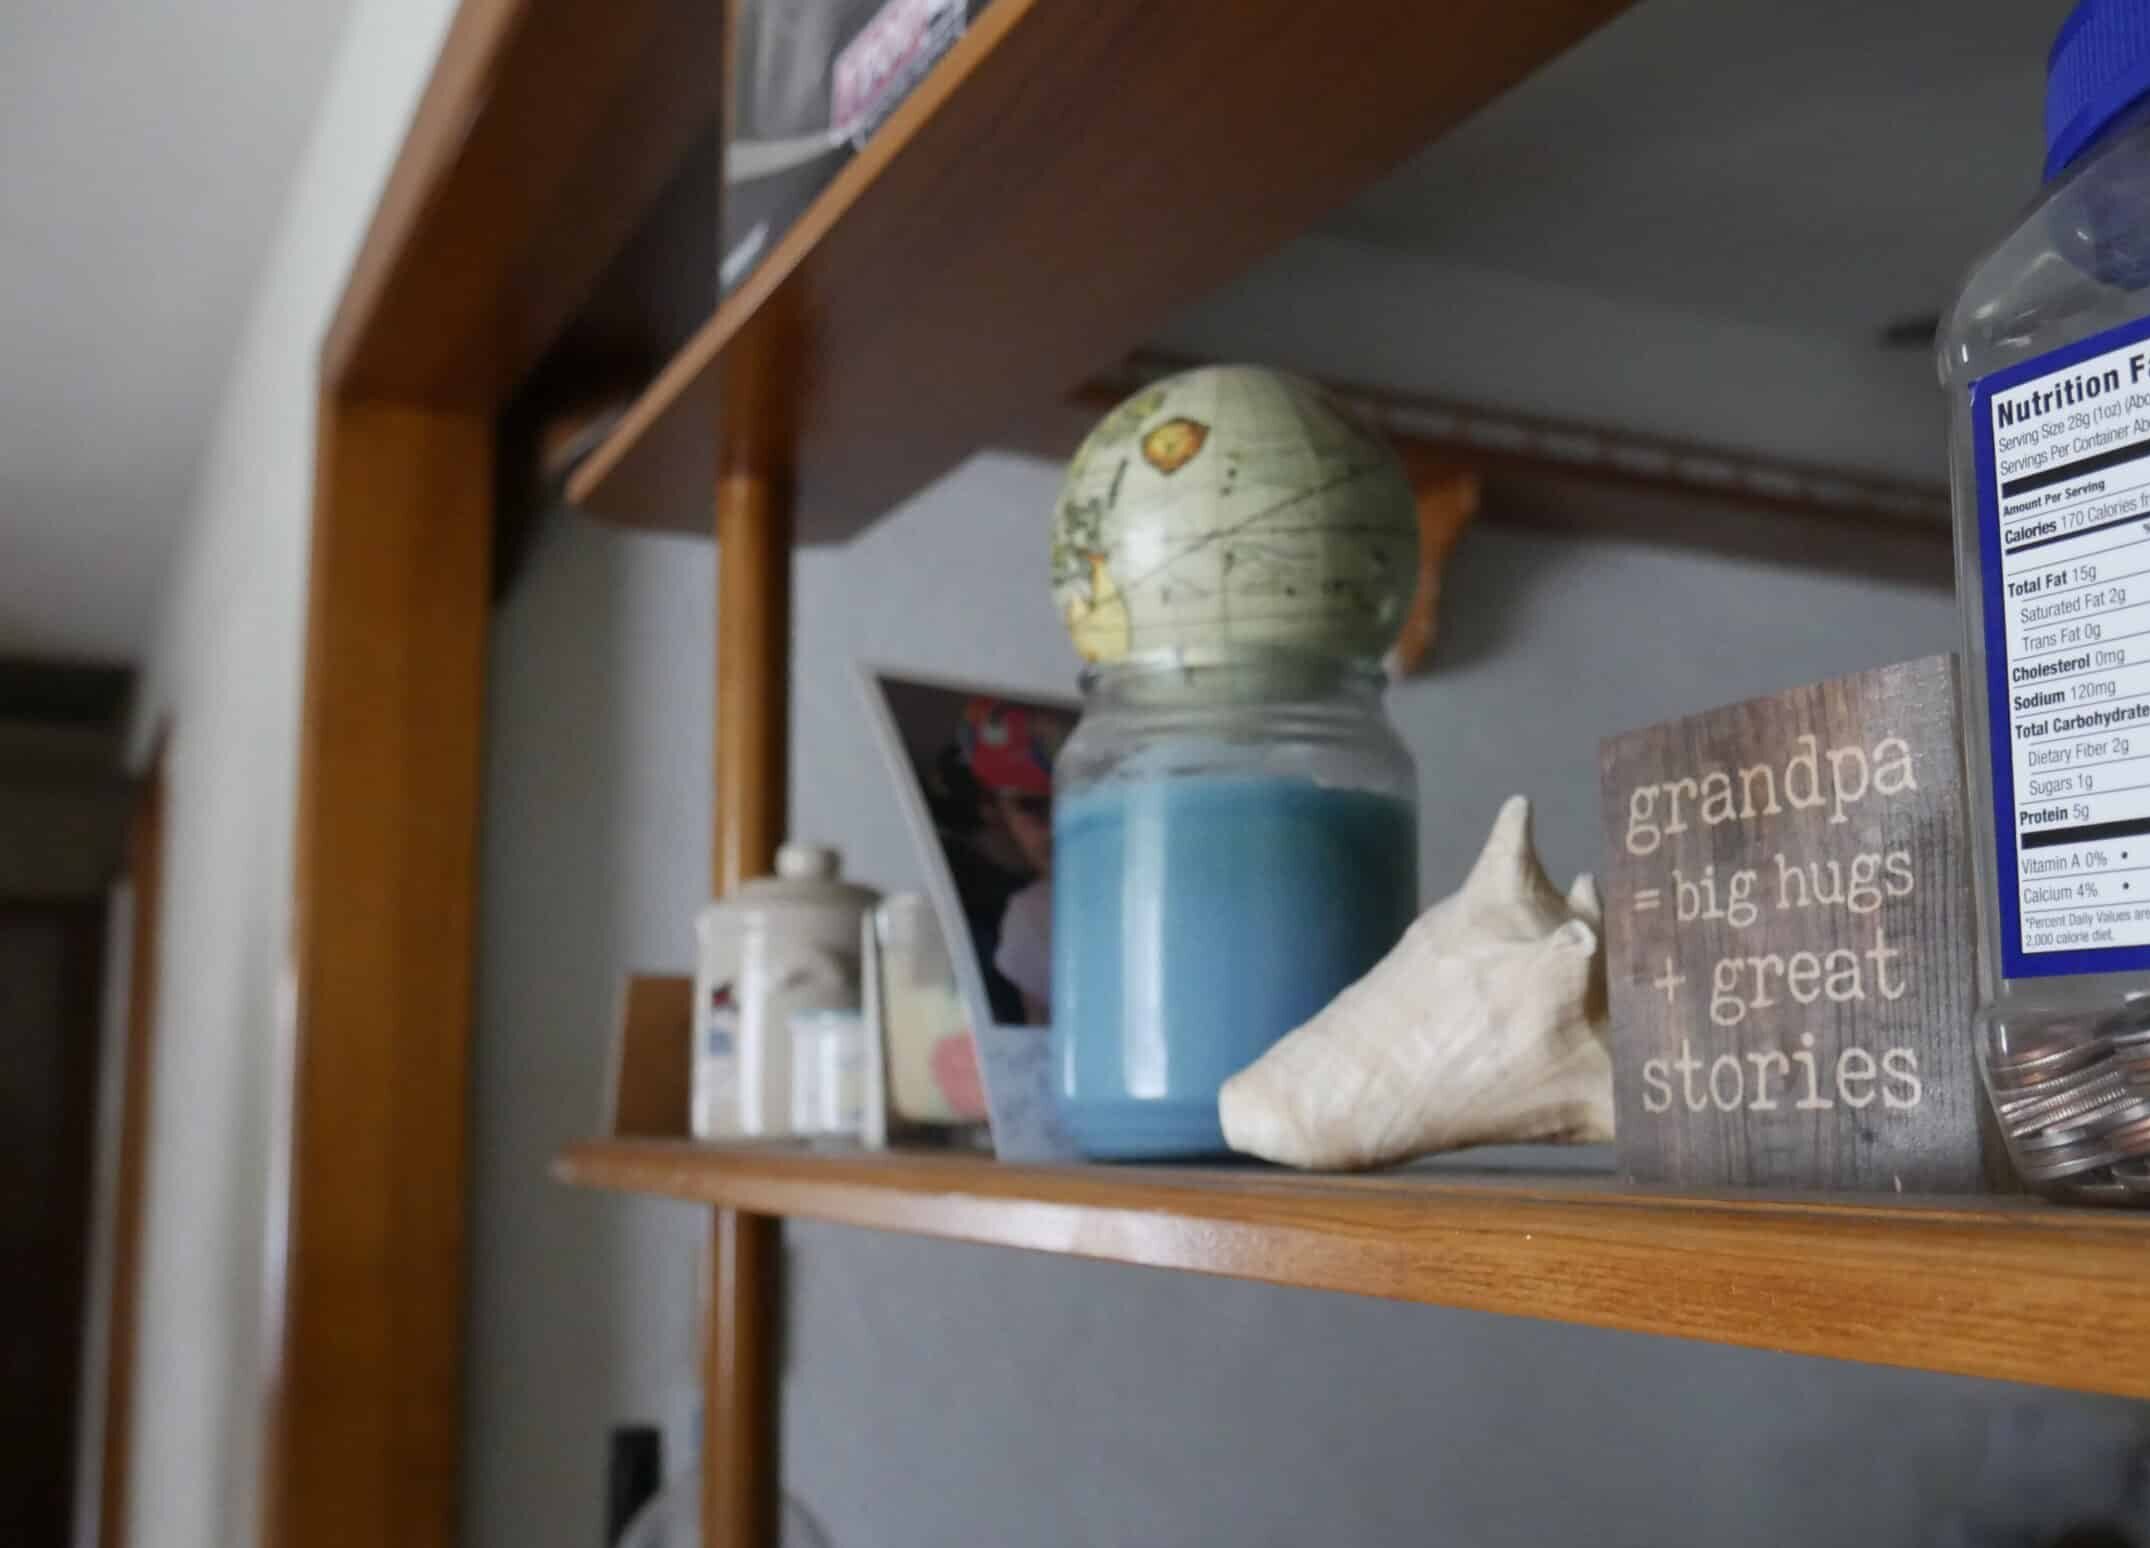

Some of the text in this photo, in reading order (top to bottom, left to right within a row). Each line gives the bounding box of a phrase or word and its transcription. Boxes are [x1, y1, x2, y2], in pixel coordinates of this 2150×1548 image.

[1998, 354, 2150, 429] Nutrition F
[1999, 429, 2039, 452] Serving
[2041, 421, 2065, 438] Size
[2068, 413, 2090, 430] 28g
[2093, 400, 2122, 425] (1oz)
[2000, 449, 2049, 476] Servings
[2050, 443, 2069, 460] Per
[2073, 424, 2130, 453] Container
[2003, 479, 2105, 517] Amount Per Serving
[2004, 519, 2057, 545] Calories
[2061, 511, 2084, 529] 170
[2088, 497, 2137, 522] Calories
[2008, 565, 2097, 598] Total Fat 15g
[2020, 587, 2126, 624] Saturated Fat 2g
[2022, 622, 2101, 652] Trans Fat 0g
[2012, 649, 2125, 682] Cholesterol 0mg
[2014, 680, 2116, 711] Sodium 120mg
[2015, 703, 2150, 739] Total Carbohydrate
[2028, 737, 2129, 767] Dietary Fiber 2g
[1625, 734, 1918, 855] grandpa
[2029, 774, 2093, 797] Sugars 1g
[2019, 803, 2089, 826] Protein 5g
[2021, 849, 2108, 875] Vitamin A 0%
[1673, 865, 1757, 928] big
[1774, 849, 1915, 914] hugs
[2023, 881, 2098, 905] Calcium 4%
[2068, 911, 2093, 927] Daily
[2096, 908, 2131, 924] Values
[1653, 928, 1906, 1026] + great
[1642, 1031, 1922, 1114] stories
